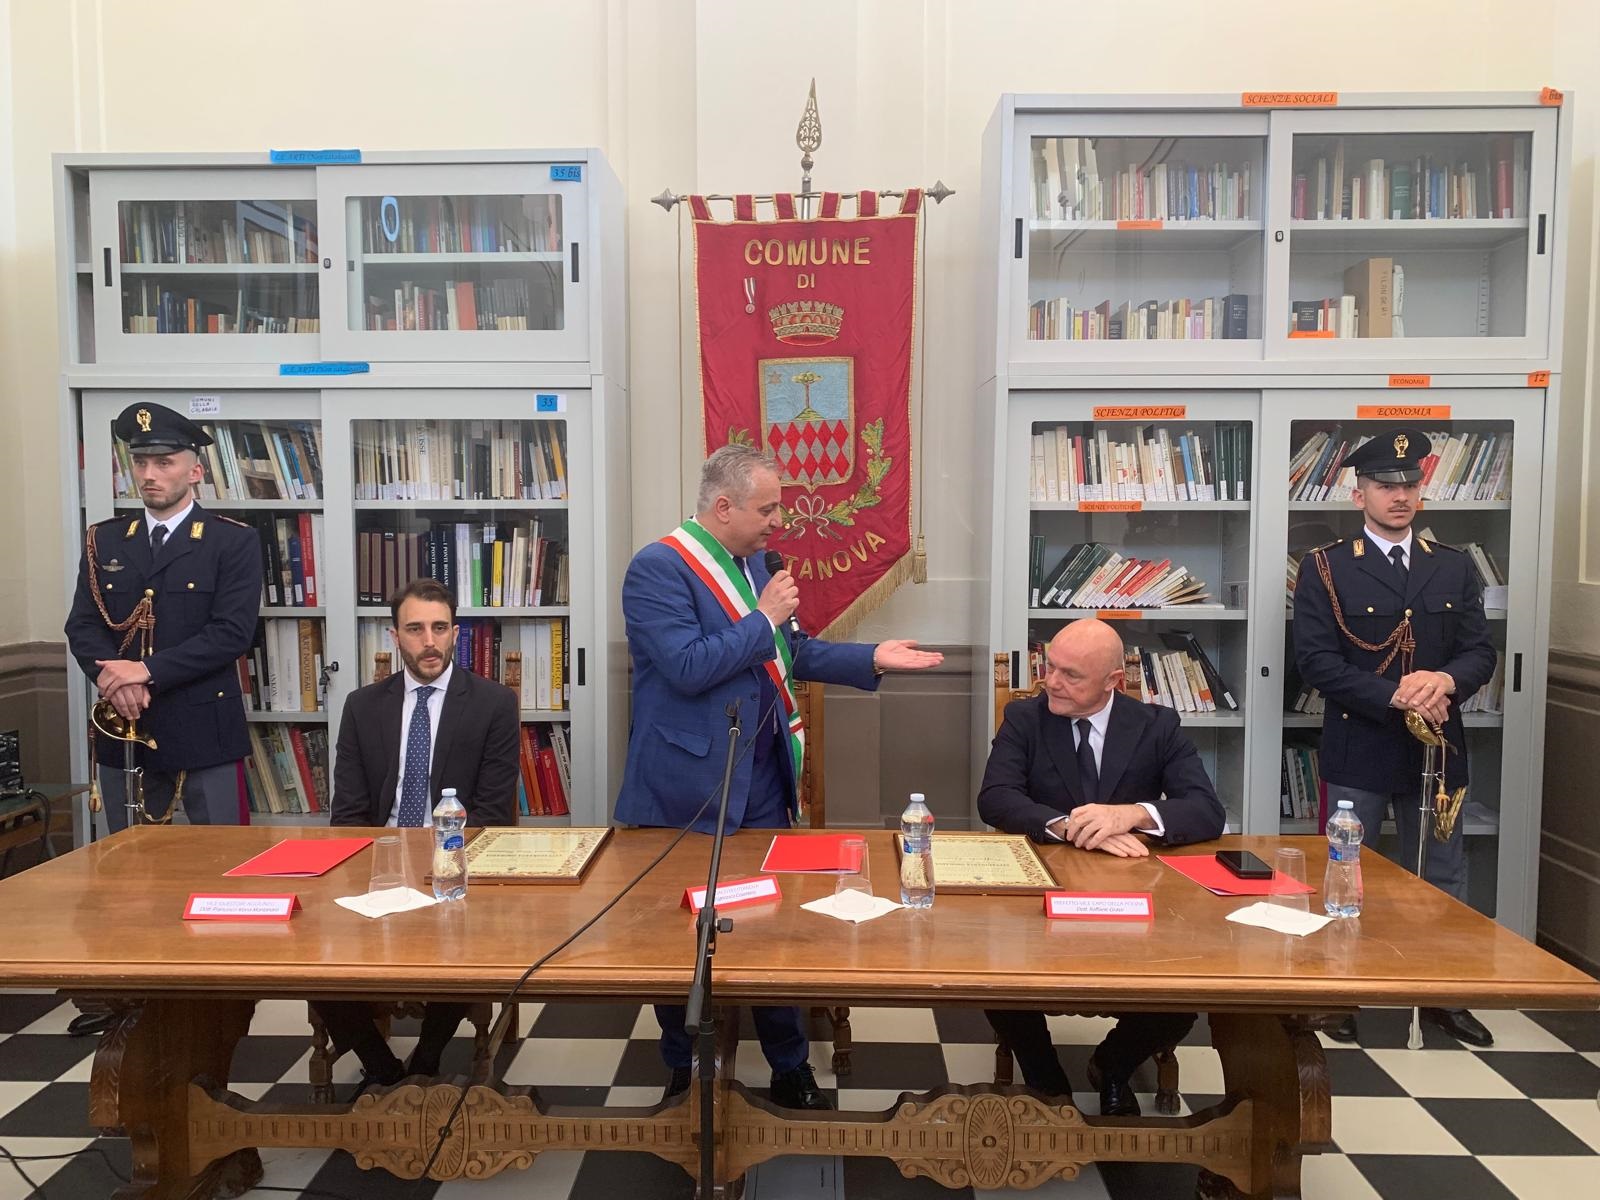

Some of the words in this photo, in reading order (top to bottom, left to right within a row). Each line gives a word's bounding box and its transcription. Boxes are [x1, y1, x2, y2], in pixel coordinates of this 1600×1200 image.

[1246, 94, 1292, 104] SCIENZE
[1292, 93, 1335, 103] SOCIALI
[744, 237, 871, 266] COMUNE
[797, 273, 815, 289] DI
[1392, 377, 1425, 385] ECONOMIA
[541, 397, 553, 407] 35
[1094, 407, 1138, 417] SCIENZA
[1140, 407, 1185, 417] POLITICA
[1376, 407, 1432, 417] ECONOMIA
[780, 531, 887, 581] TANOVA
[303, 653, 312, 692] NOUVEAU
